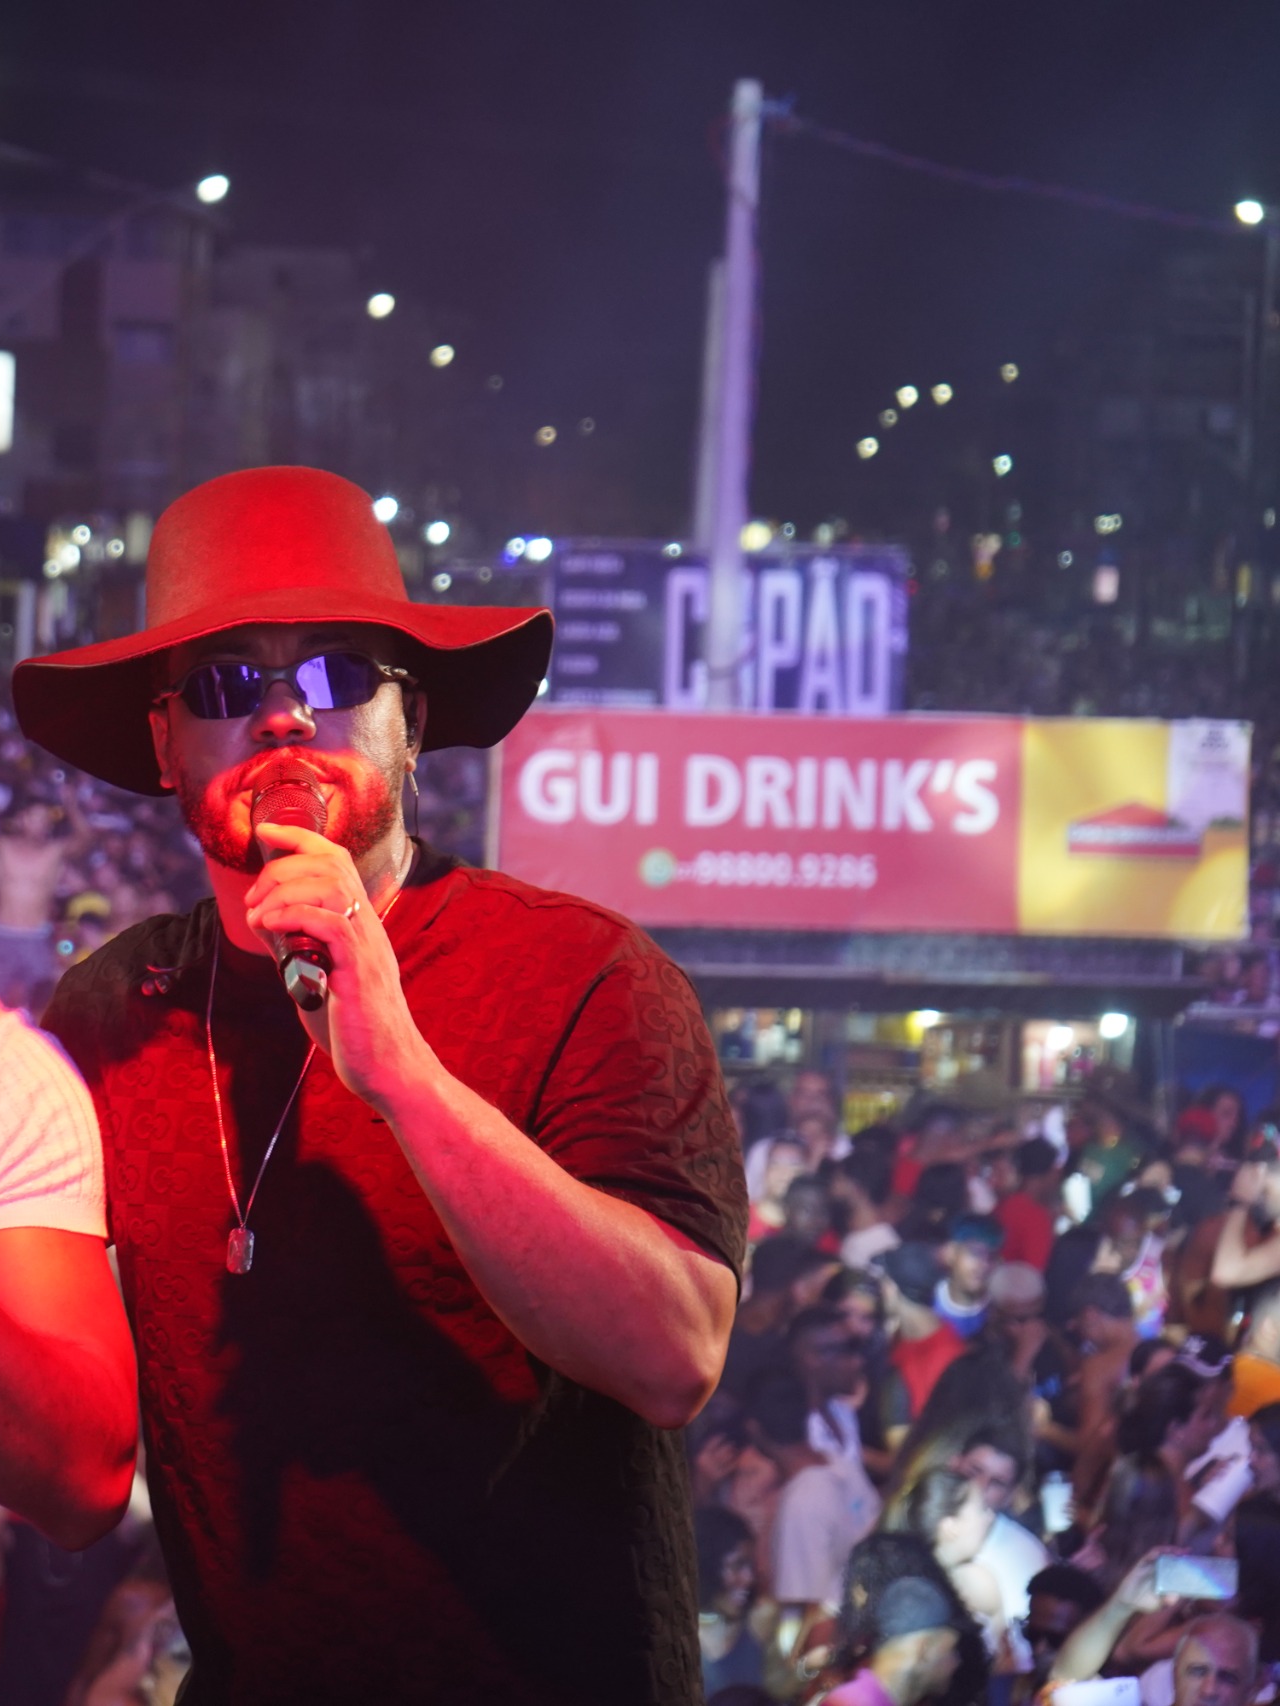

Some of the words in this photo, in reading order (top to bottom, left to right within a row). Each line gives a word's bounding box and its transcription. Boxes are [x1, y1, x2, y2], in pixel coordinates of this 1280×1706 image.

[666, 557, 892, 713] CPÃO
[520, 749, 658, 825] GUI
[685, 753, 1000, 835] DRINK'S
